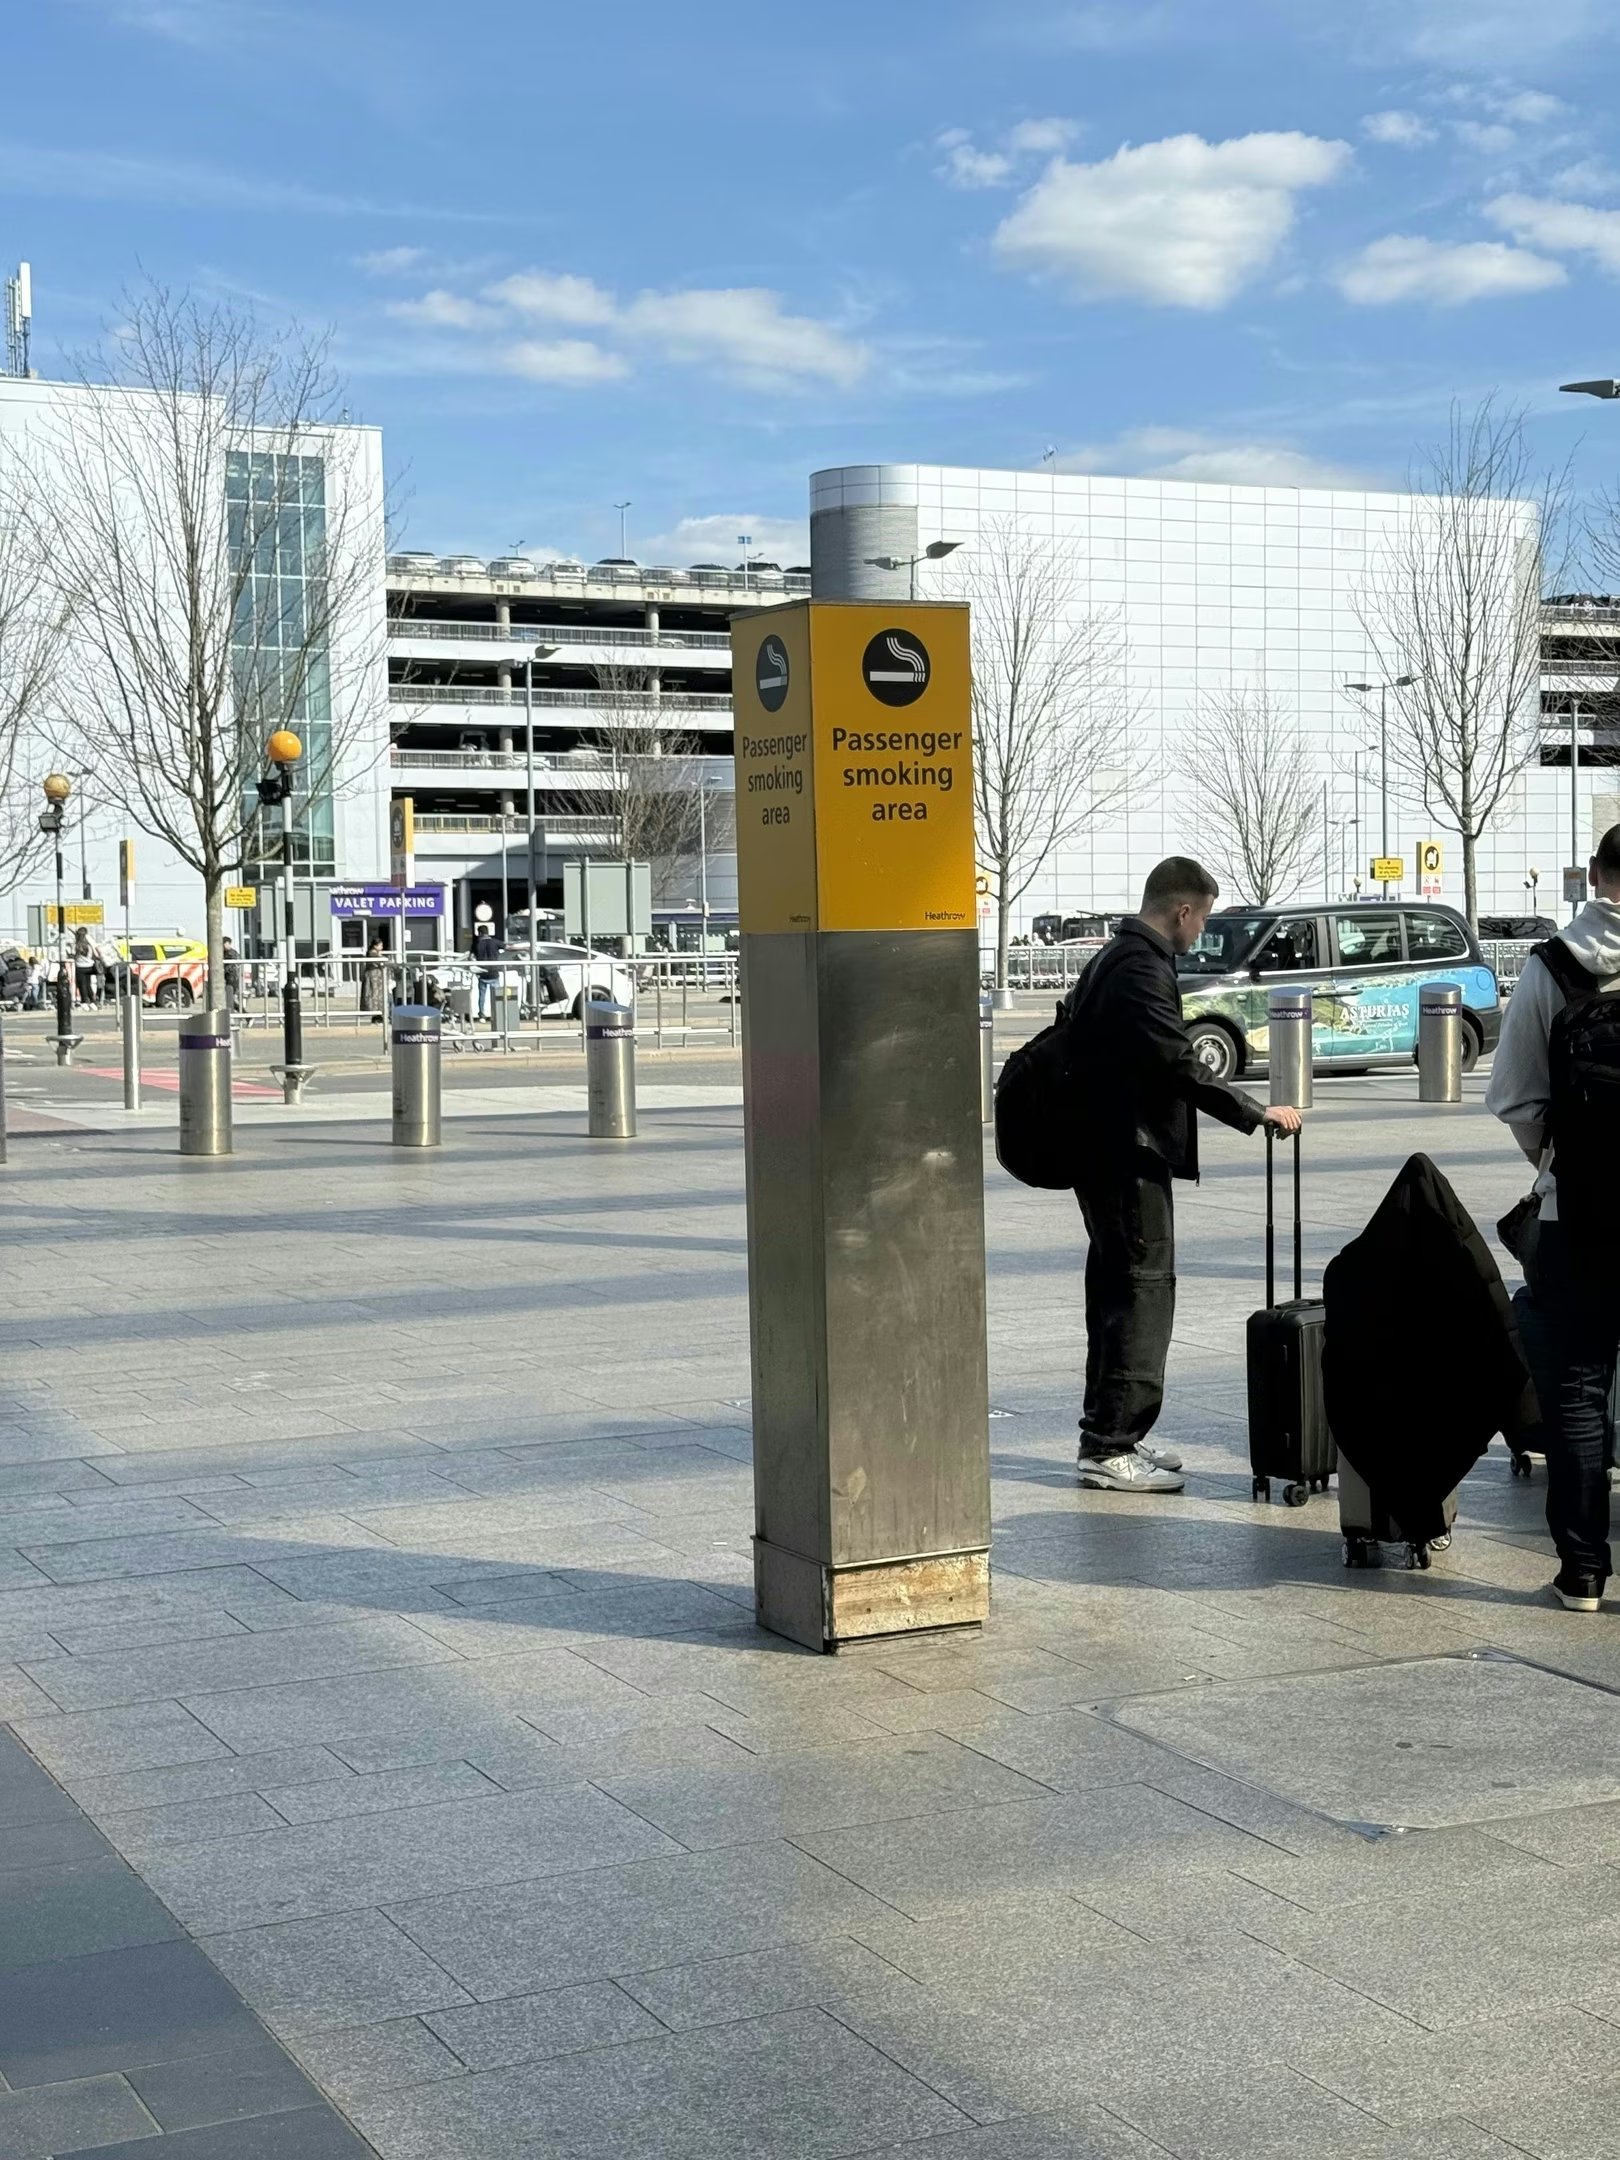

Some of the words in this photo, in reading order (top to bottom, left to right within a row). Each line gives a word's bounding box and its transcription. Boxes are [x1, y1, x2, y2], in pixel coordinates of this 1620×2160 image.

[742, 732, 808, 760] Passenger
[832, 727, 963, 757] Passenger
[748, 765, 803, 794] smoking
[843, 761, 953, 791] smoking
[762, 805, 790, 825] area
[872, 802, 927, 821] area
[335, 897, 375, 908] VALET
[380, 896, 435, 908] PARKING
[925, 911, 966, 920] Heathrow
[1340, 1004, 1409, 1020] ASTURIAS
[1422, 1007, 1457, 1015] Heathrow
[400, 1033, 439, 1042] Heathrow
